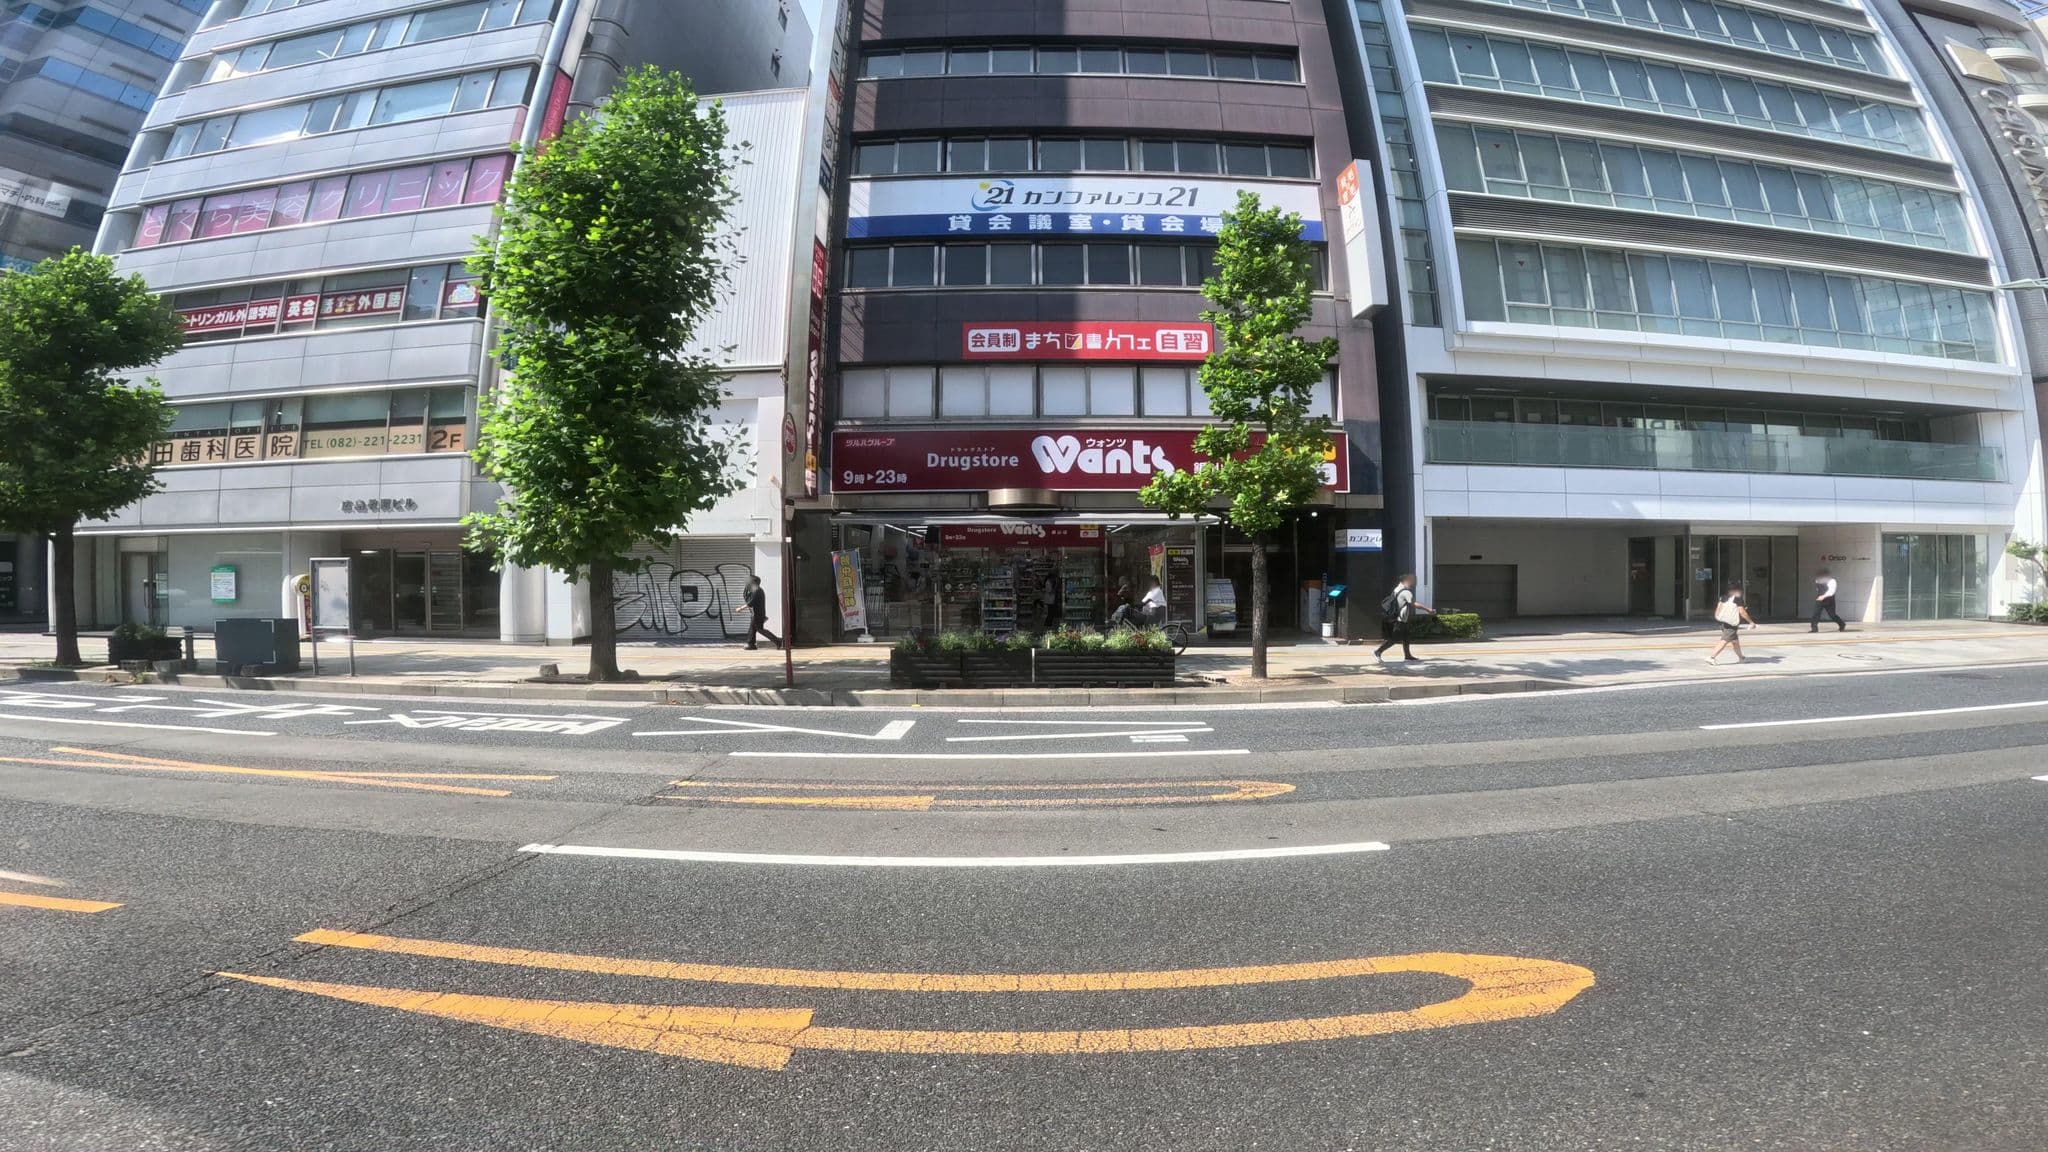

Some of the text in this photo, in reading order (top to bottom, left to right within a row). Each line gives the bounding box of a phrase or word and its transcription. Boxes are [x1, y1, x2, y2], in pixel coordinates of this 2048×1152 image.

[1022, 186, 1199, 207] カンファレンス21
[970, 331, 1017, 349] 会員制
[1161, 332, 1204, 351] 自習
[303, 439, 323, 449] TEL
[431, 429, 462, 450] 2F
[1085, 438, 1127, 448] ウォンツ
[927, 452, 1020, 471] Drugstore
[1031, 435, 1176, 478] Wants
